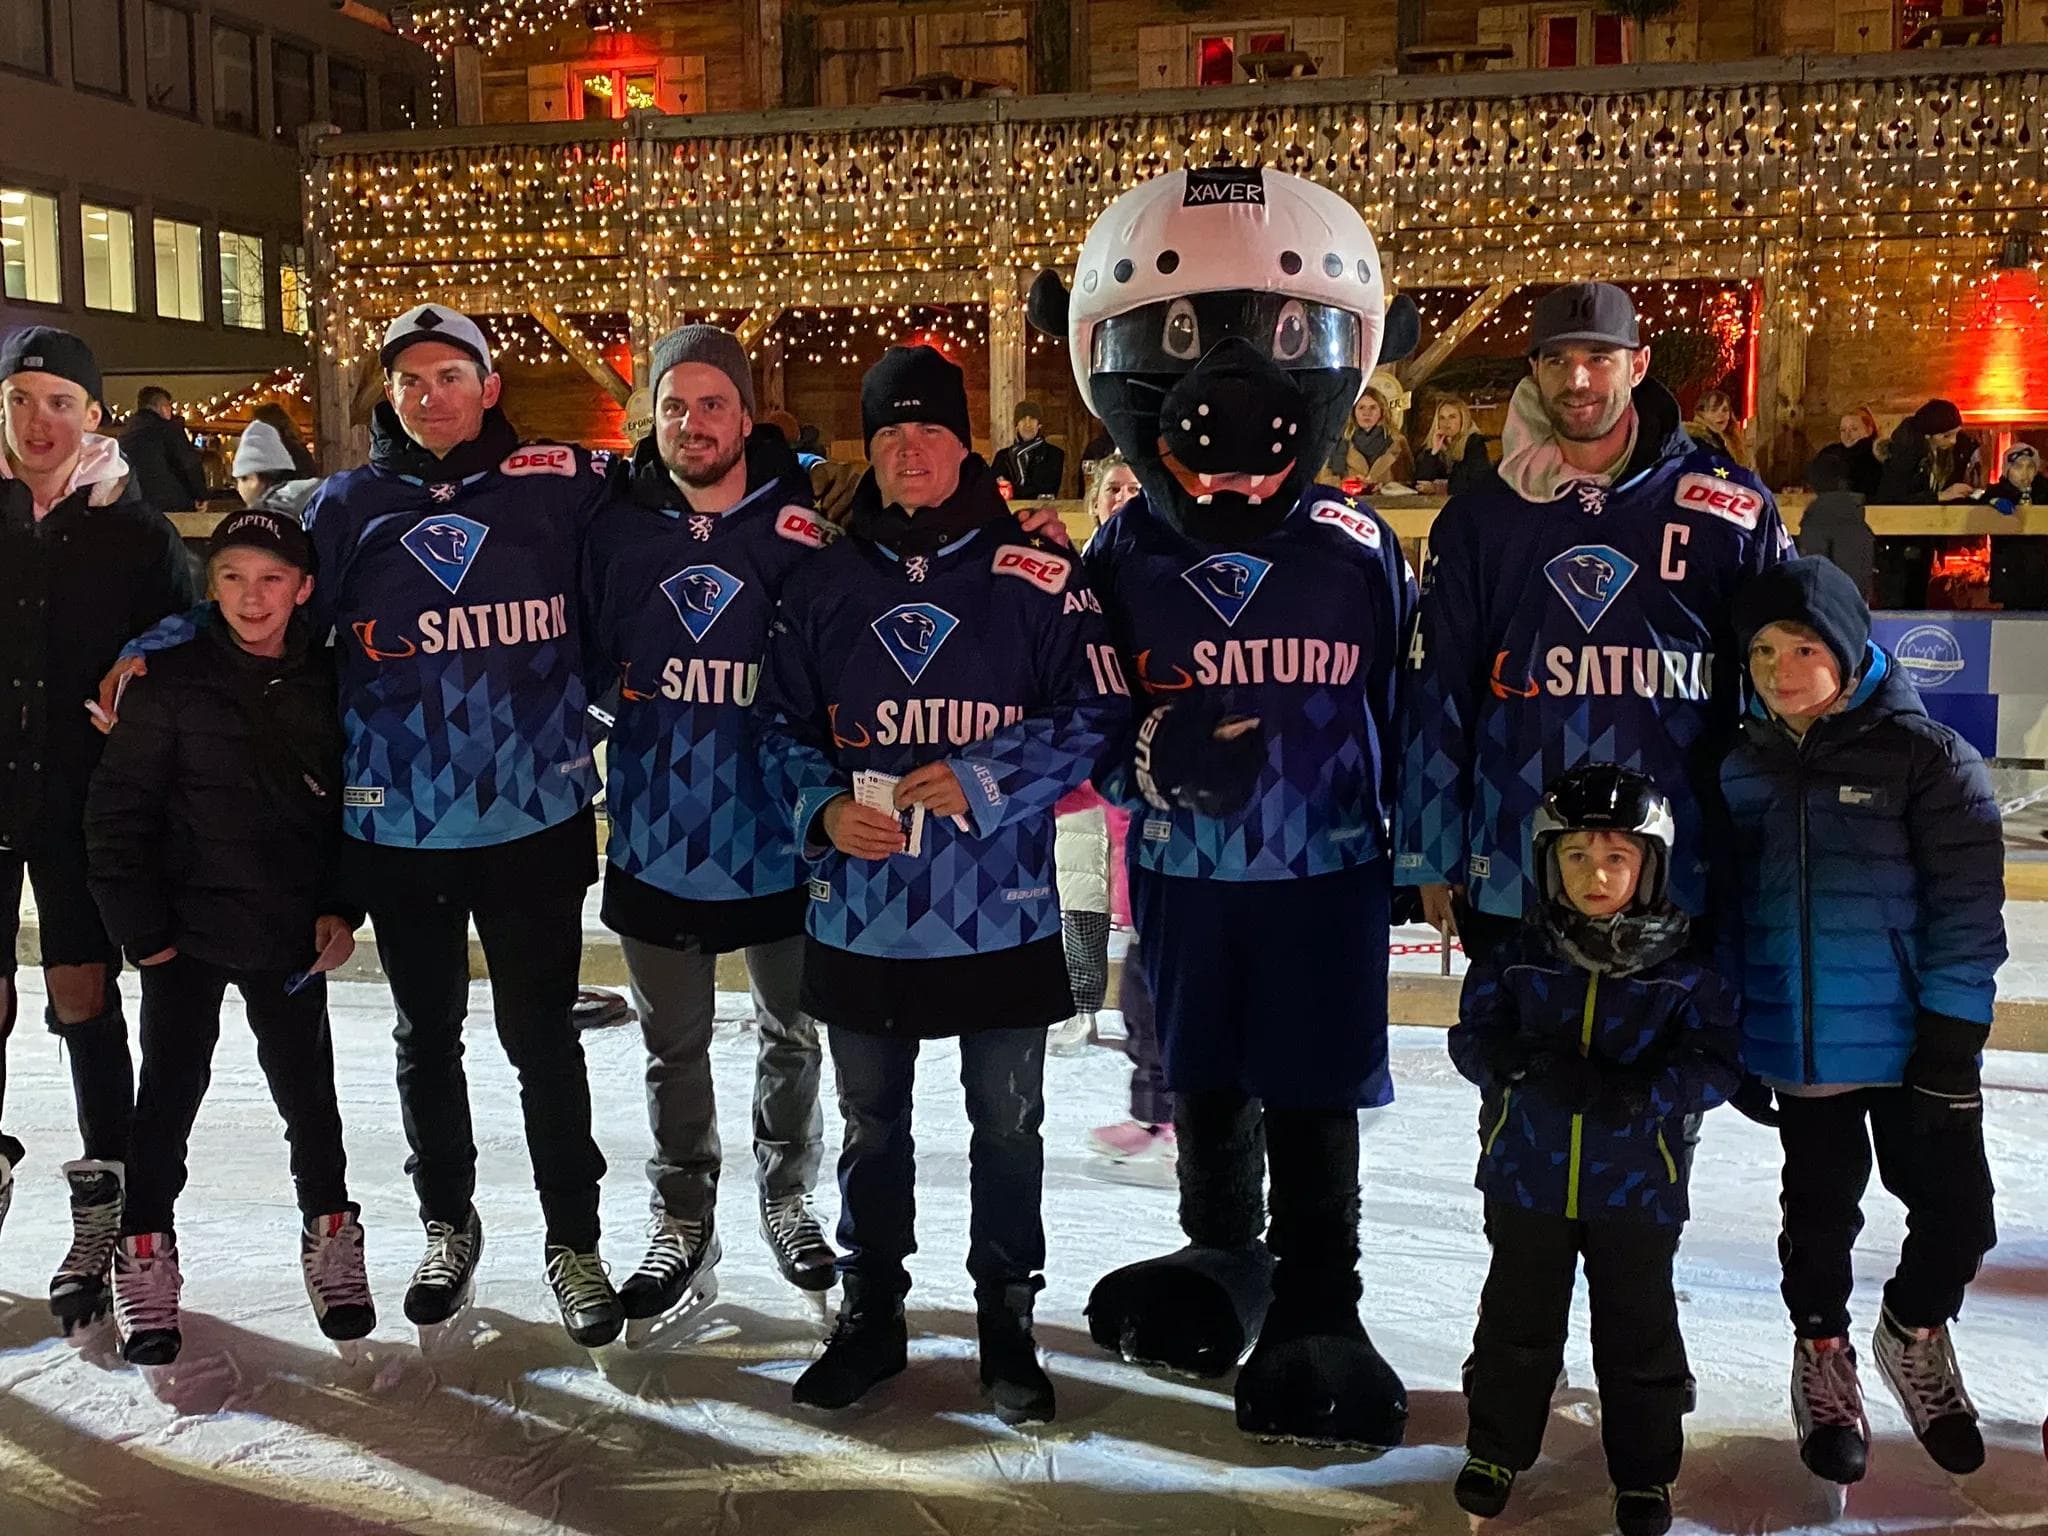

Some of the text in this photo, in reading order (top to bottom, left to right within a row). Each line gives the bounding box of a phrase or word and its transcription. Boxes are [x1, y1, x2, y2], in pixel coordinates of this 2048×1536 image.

[1188, 183, 1262, 202] XAVER
[227, 514, 281, 540] CAPITAL
[1660, 522, 1690, 581] C
[418, 593, 567, 654] SATURN
[661, 657, 760, 707] SATU
[1086, 643, 1132, 696] 10
[1193, 638, 1360, 686] SATURN
[1546, 645, 1715, 700] SATURN
